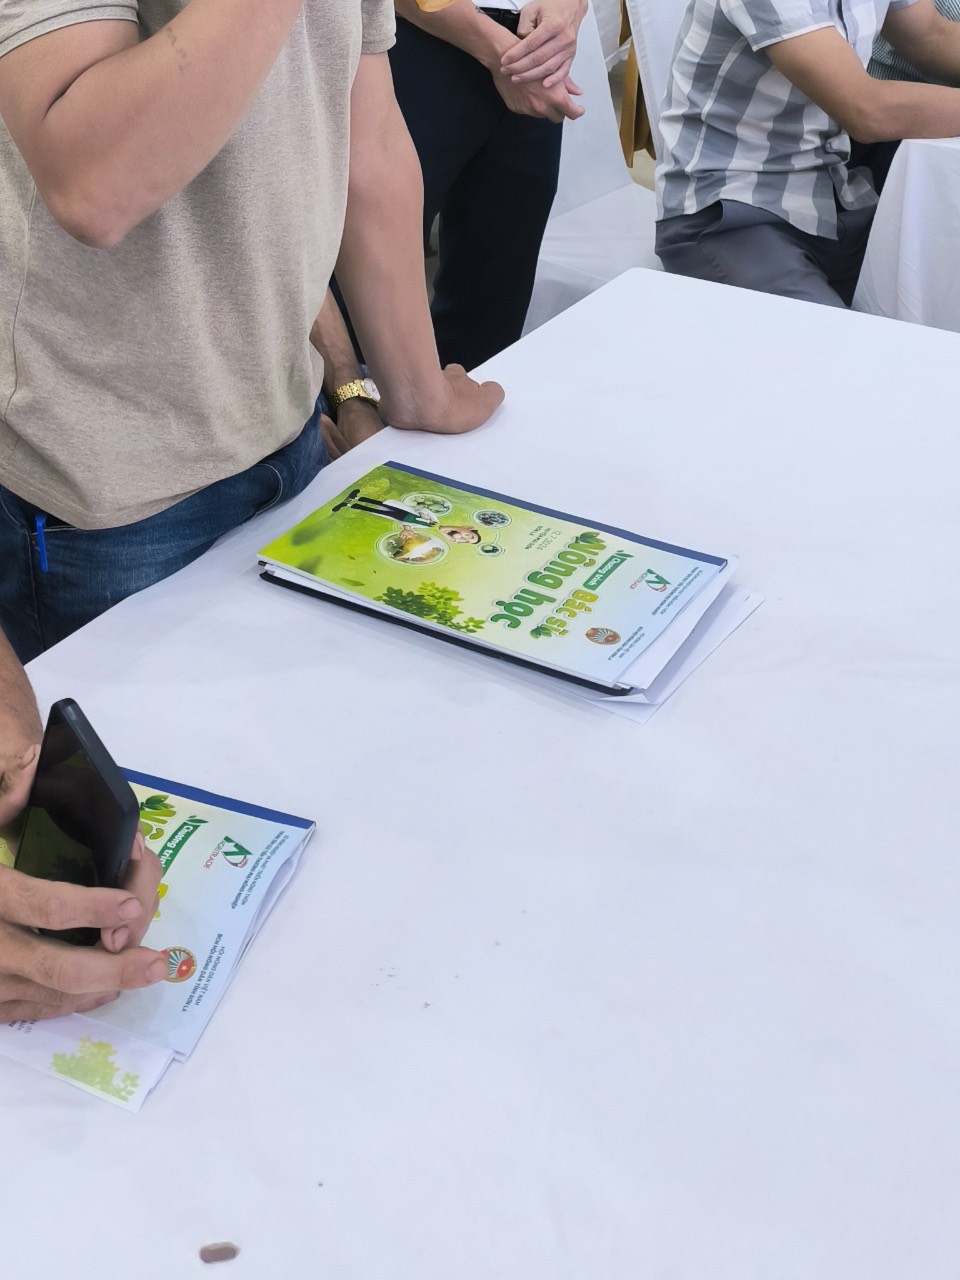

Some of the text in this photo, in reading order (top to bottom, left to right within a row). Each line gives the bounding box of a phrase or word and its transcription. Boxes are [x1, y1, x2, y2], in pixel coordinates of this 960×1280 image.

[490, 541, 607, 629] Nông học
[556, 589, 599, 618] Bác
[541, 616, 569, 636] sĩ
[167, 825, 193, 849] Chương
[160, 849, 174, 867] trìn
